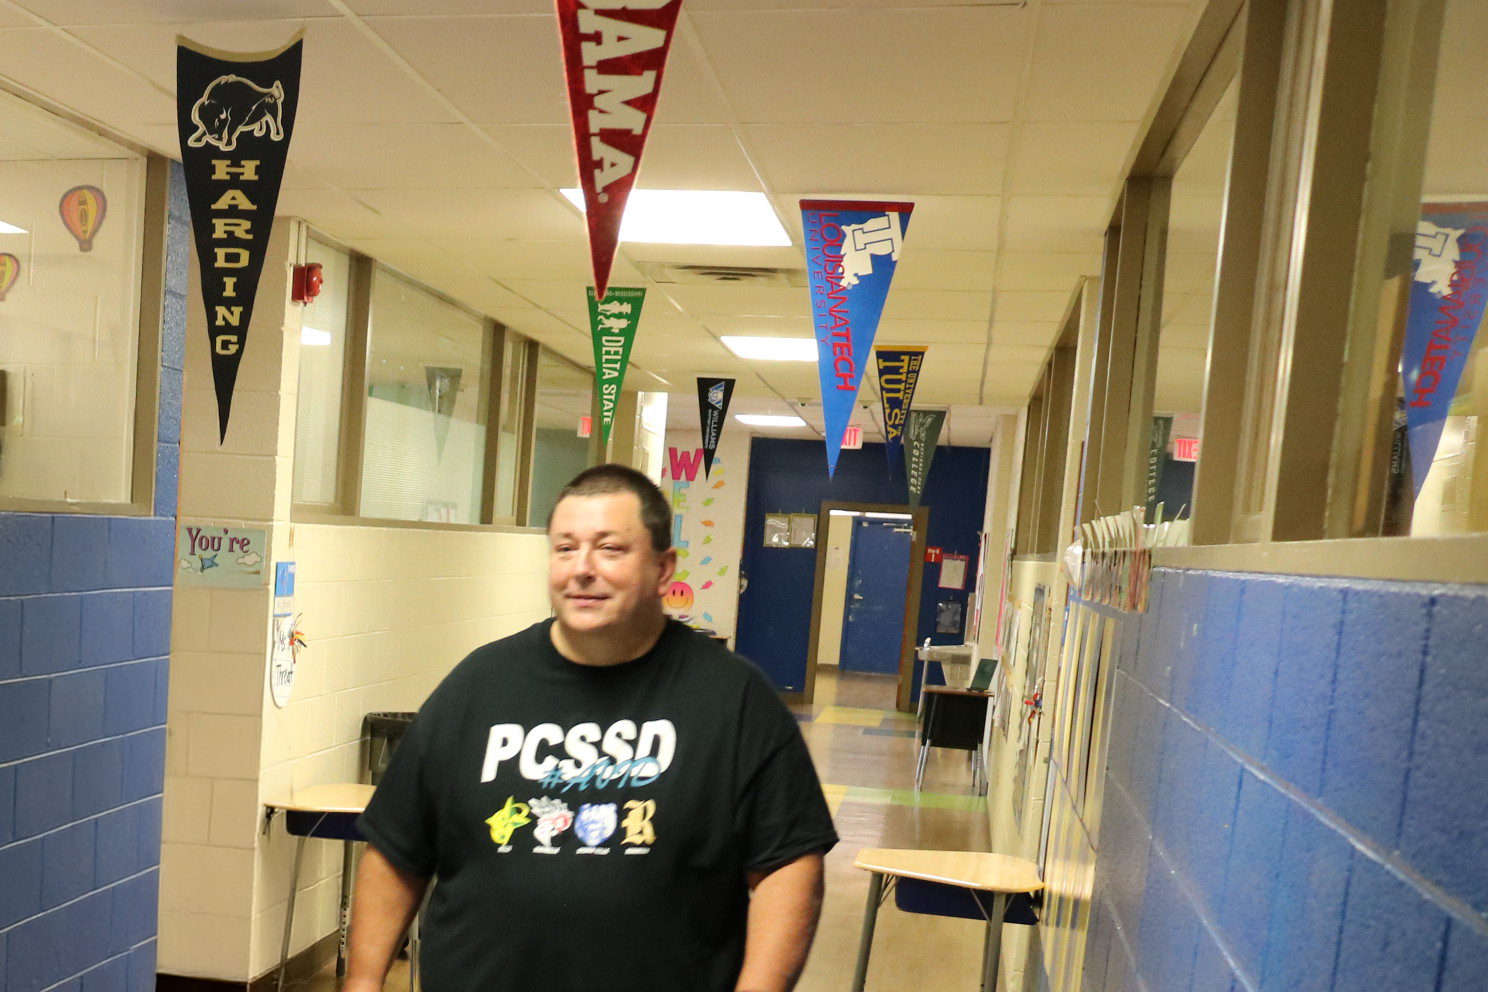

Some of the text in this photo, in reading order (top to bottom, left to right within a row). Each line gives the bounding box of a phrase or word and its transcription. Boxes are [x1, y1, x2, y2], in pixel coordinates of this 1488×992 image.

[576, 0, 671, 193] AMA
[211, 159, 260, 355] HARDING
[807, 212, 829, 346] UNIVERSITY
[602, 336, 624, 425] DELTA STATE
[910, 354, 922, 371] THE
[709, 409, 719, 450] WILLIAMS
[878, 355, 909, 440] TULSA
[843, 428, 860, 447] XIT
[909, 441, 920, 494] COLLEGE
[186, 527, 251, 556] You're
[480, 719, 677, 783] PCSSD
